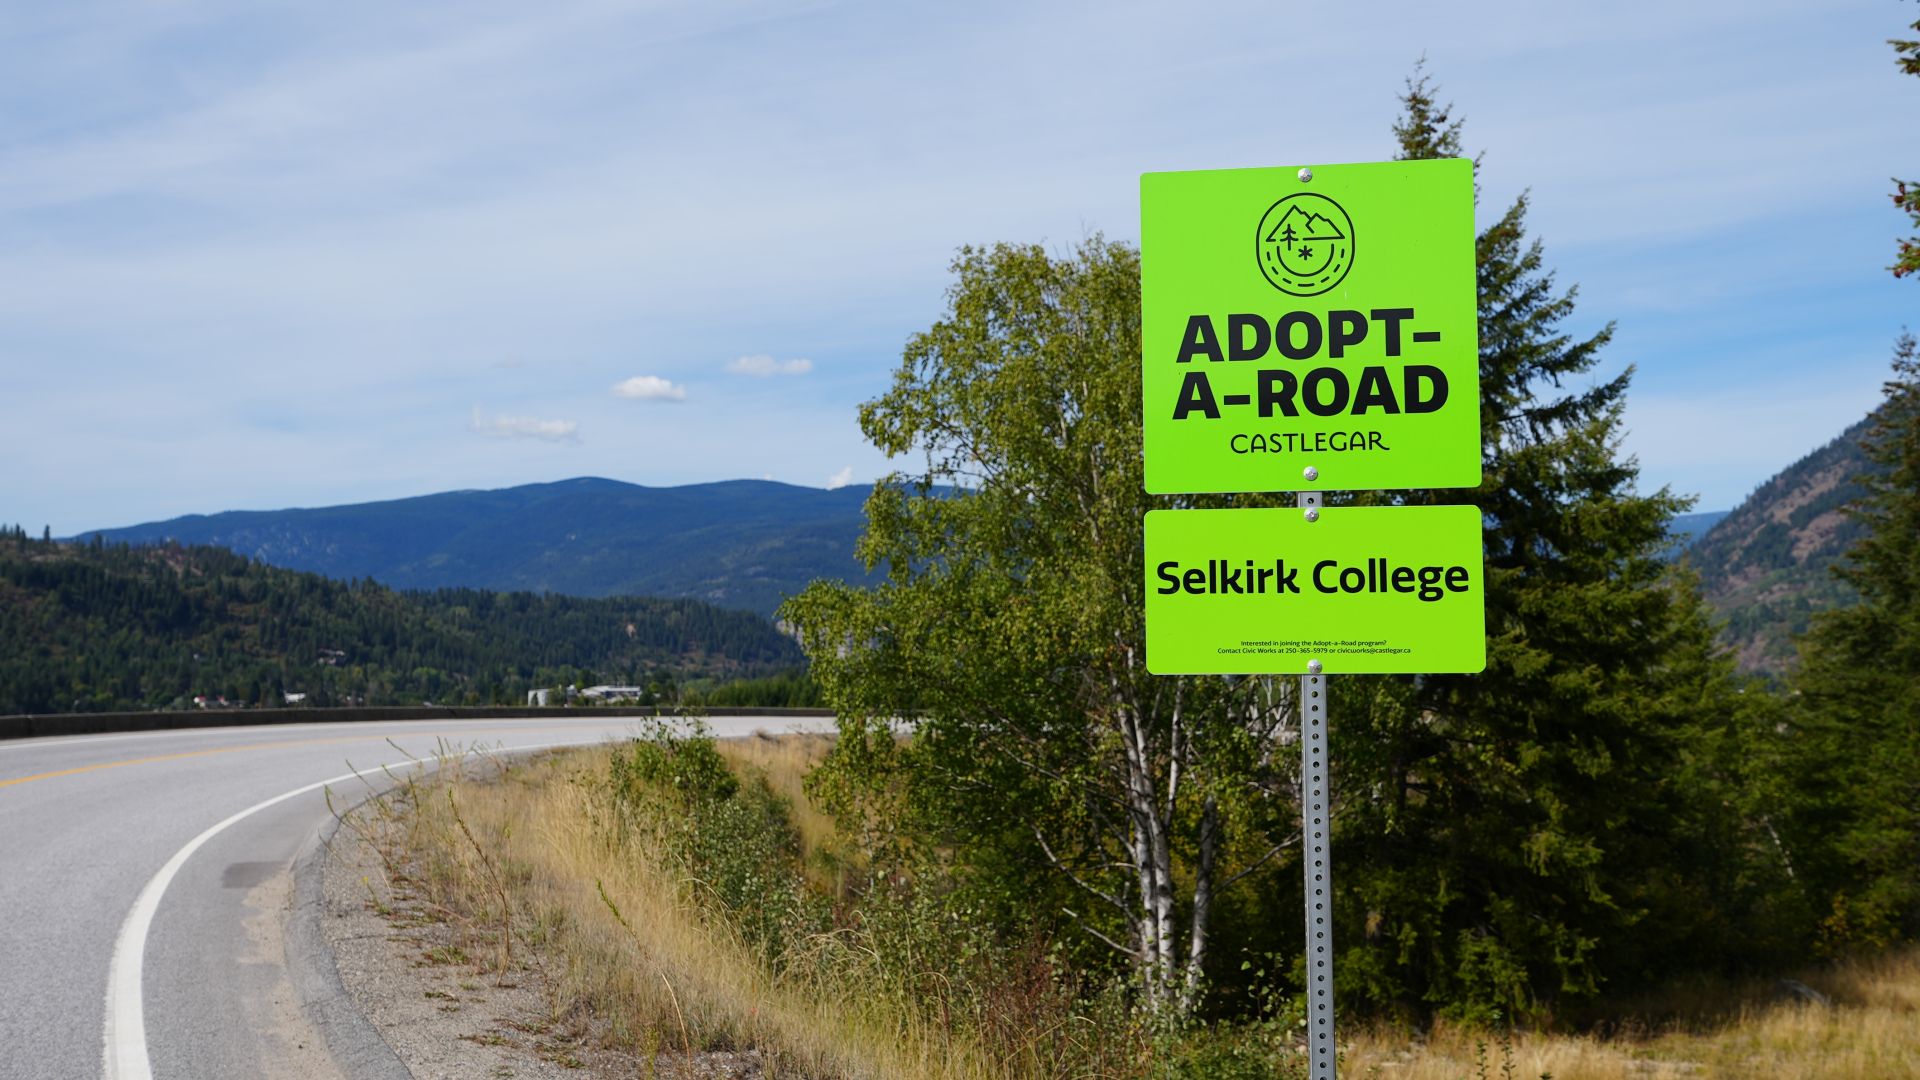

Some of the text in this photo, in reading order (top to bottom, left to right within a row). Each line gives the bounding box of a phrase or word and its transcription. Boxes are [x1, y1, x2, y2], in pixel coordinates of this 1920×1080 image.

[1176, 308, 1440, 363] ADOPT-
[1172, 365, 1449, 420] A-ROAD
[1230, 431, 1390, 454] CASTLEGAR
[1157, 557, 1468, 602] Selkirk College
